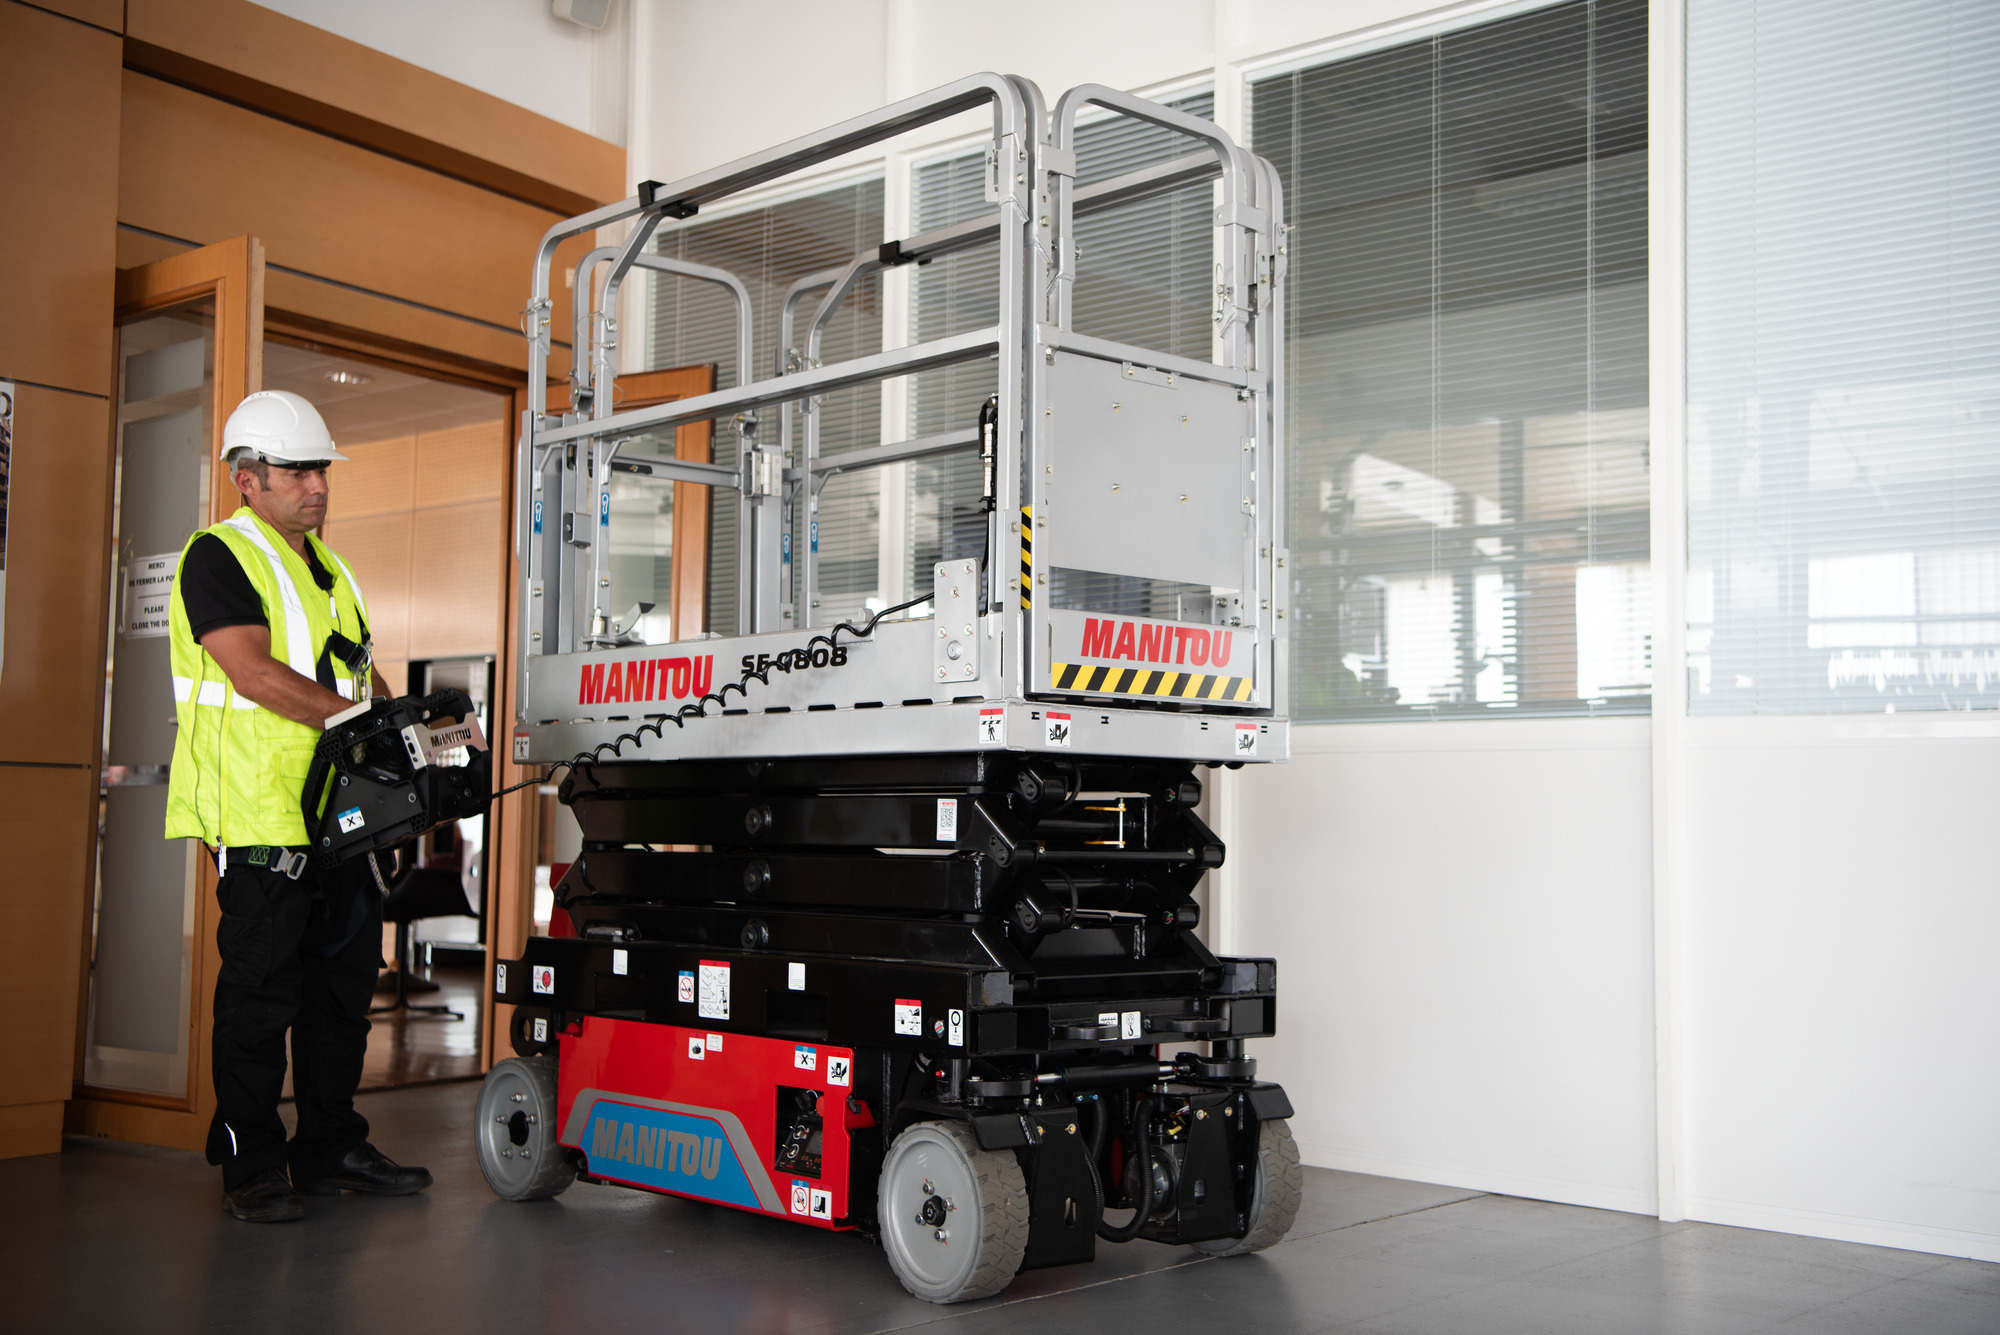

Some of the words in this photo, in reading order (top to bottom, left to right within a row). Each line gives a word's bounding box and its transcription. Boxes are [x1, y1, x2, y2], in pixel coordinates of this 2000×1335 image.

[148, 561, 165, 569] MERCI
[136, 576, 156, 585] FERMER
[157, 575, 164, 583] LA
[144, 605, 164, 614] PLEASE
[131, 621, 149, 630] CLOSE
[150, 620, 160, 628] THE
[1081, 617, 1233, 668] MANITOU
[579, 655, 713, 705] MANITOU
[430, 728, 471, 748] MANITOU
[591, 1117, 722, 1180] MANITOU
